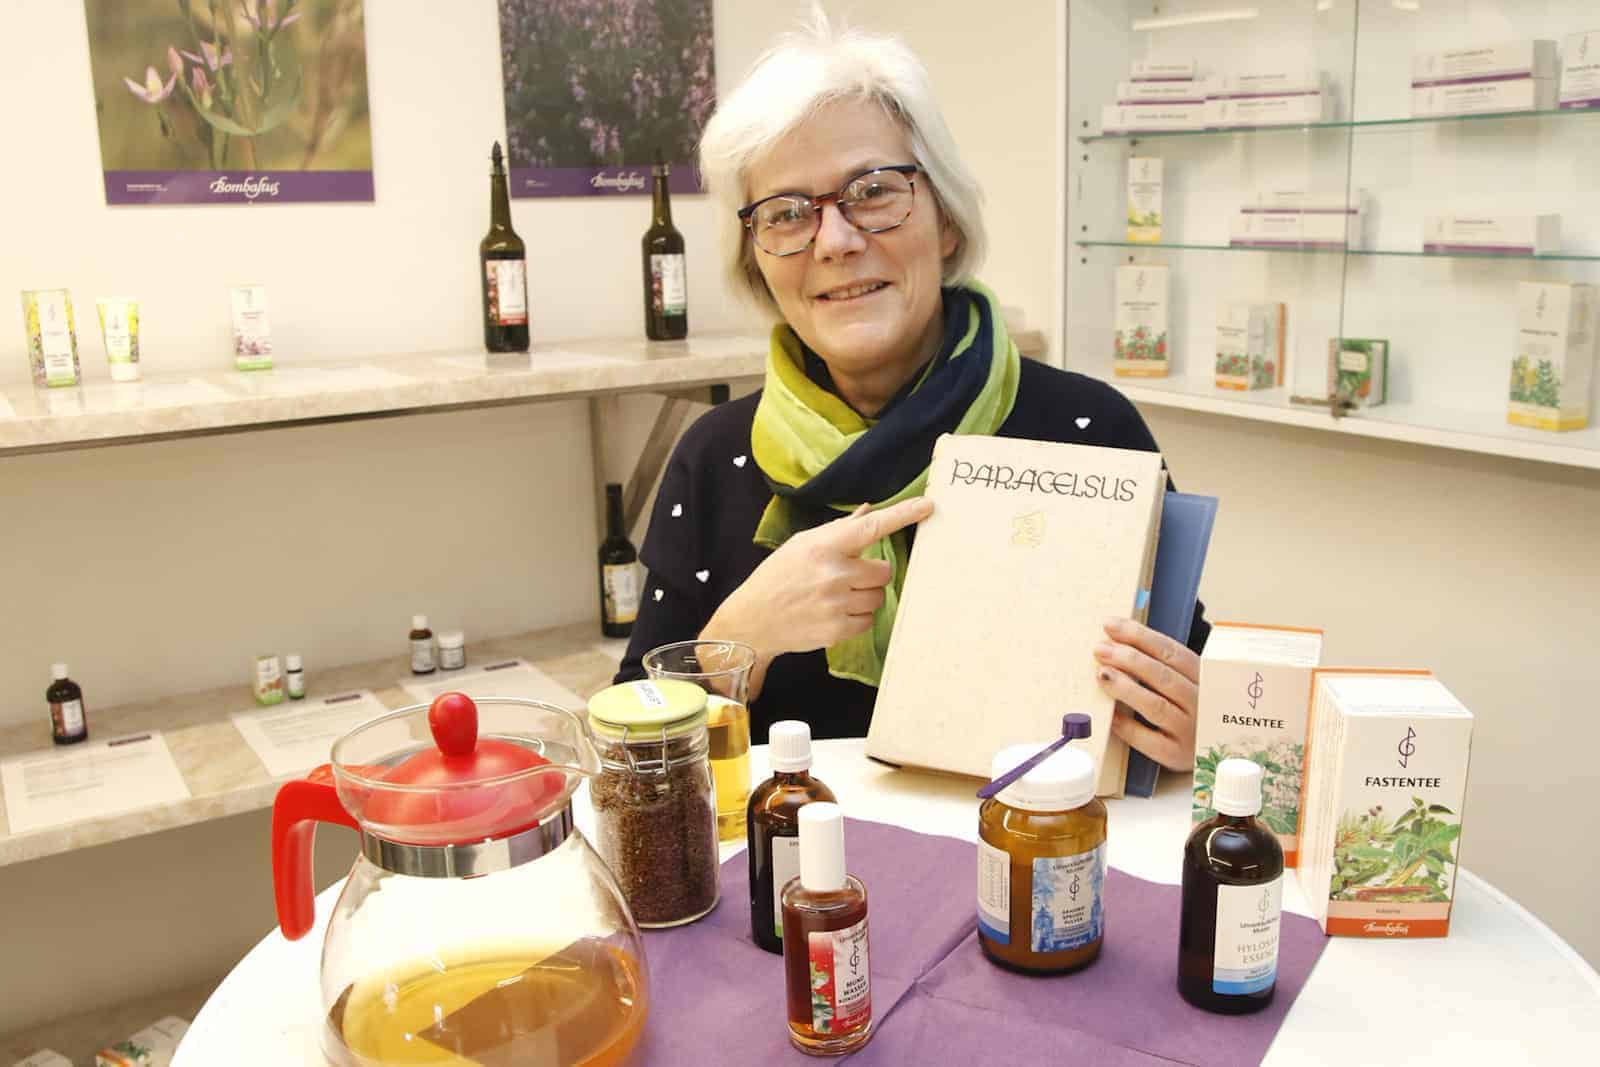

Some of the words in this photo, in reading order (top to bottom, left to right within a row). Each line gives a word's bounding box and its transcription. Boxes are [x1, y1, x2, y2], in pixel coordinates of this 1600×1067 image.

[950, 459, 1138, 502] PARACELSUS
[1222, 714, 1287, 729] BASENTEE
[1365, 776, 1441, 788] FASTENTEE
